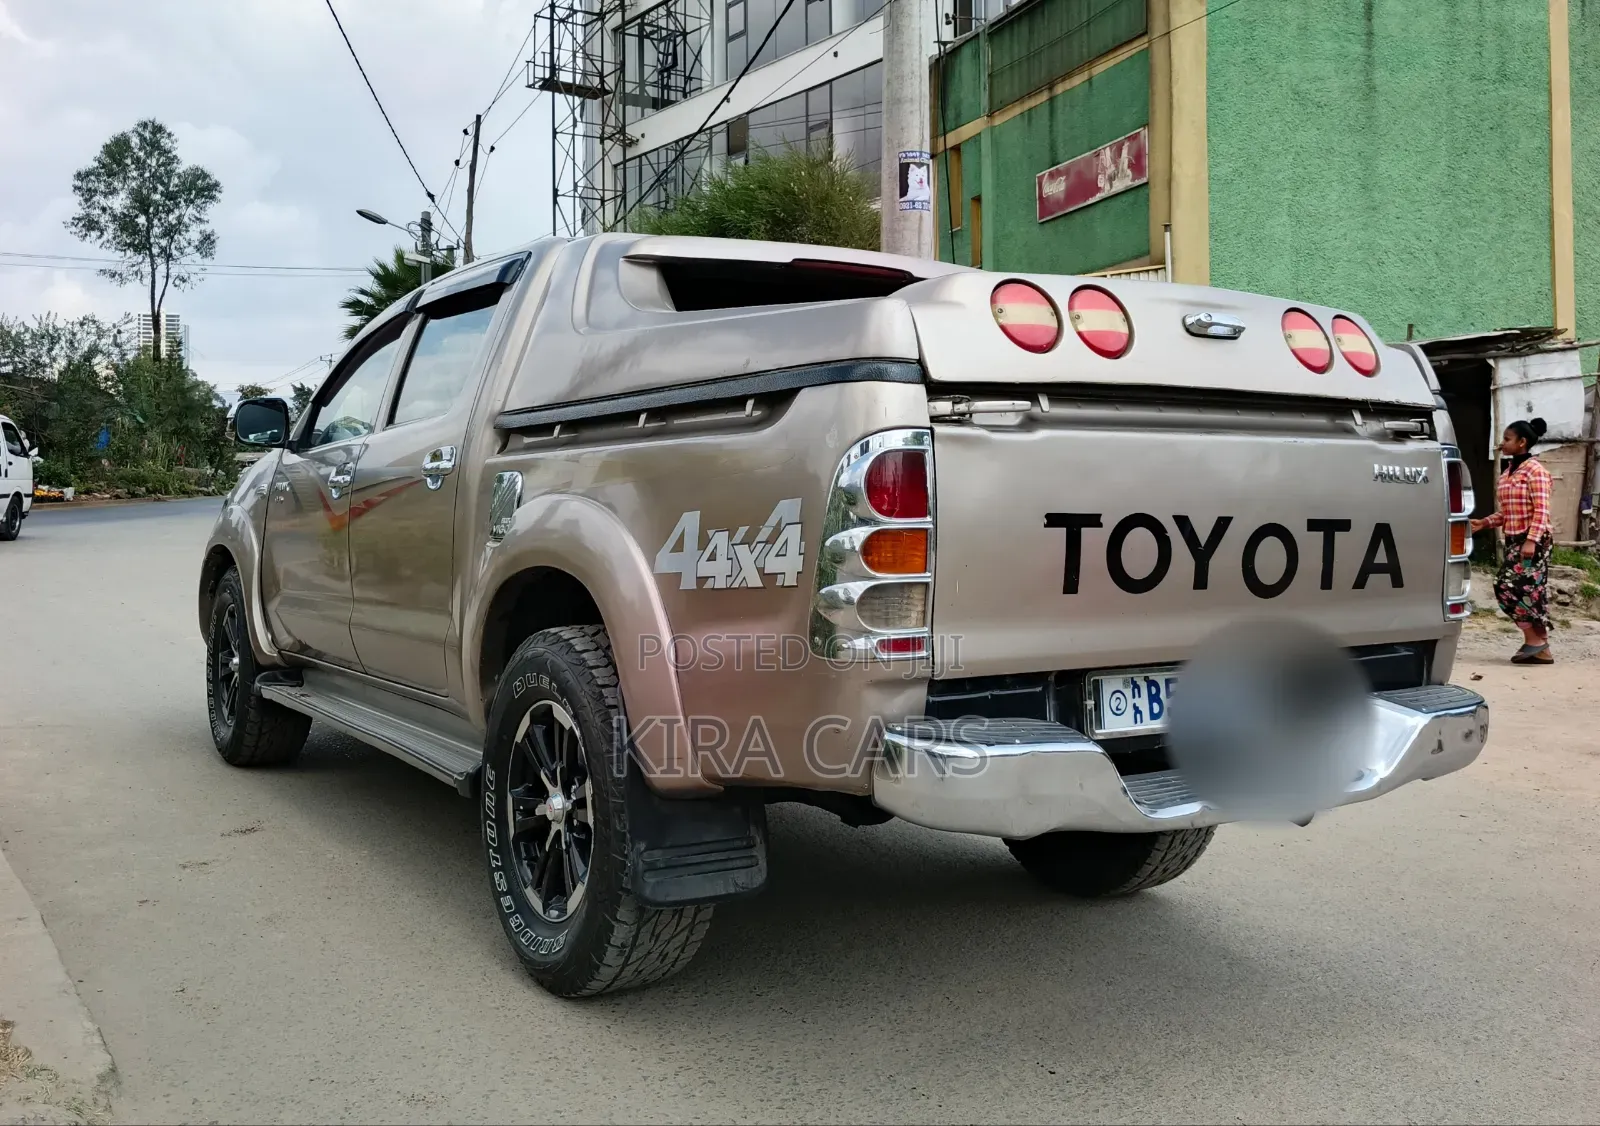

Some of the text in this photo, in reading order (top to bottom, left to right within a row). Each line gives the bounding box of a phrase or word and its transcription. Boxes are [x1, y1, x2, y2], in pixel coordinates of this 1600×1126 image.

[1373, 463, 1429, 484] HILUX
[1043, 512, 1405, 599] TOYOTA
[485, 763, 569, 955] BRIDGESTONE
